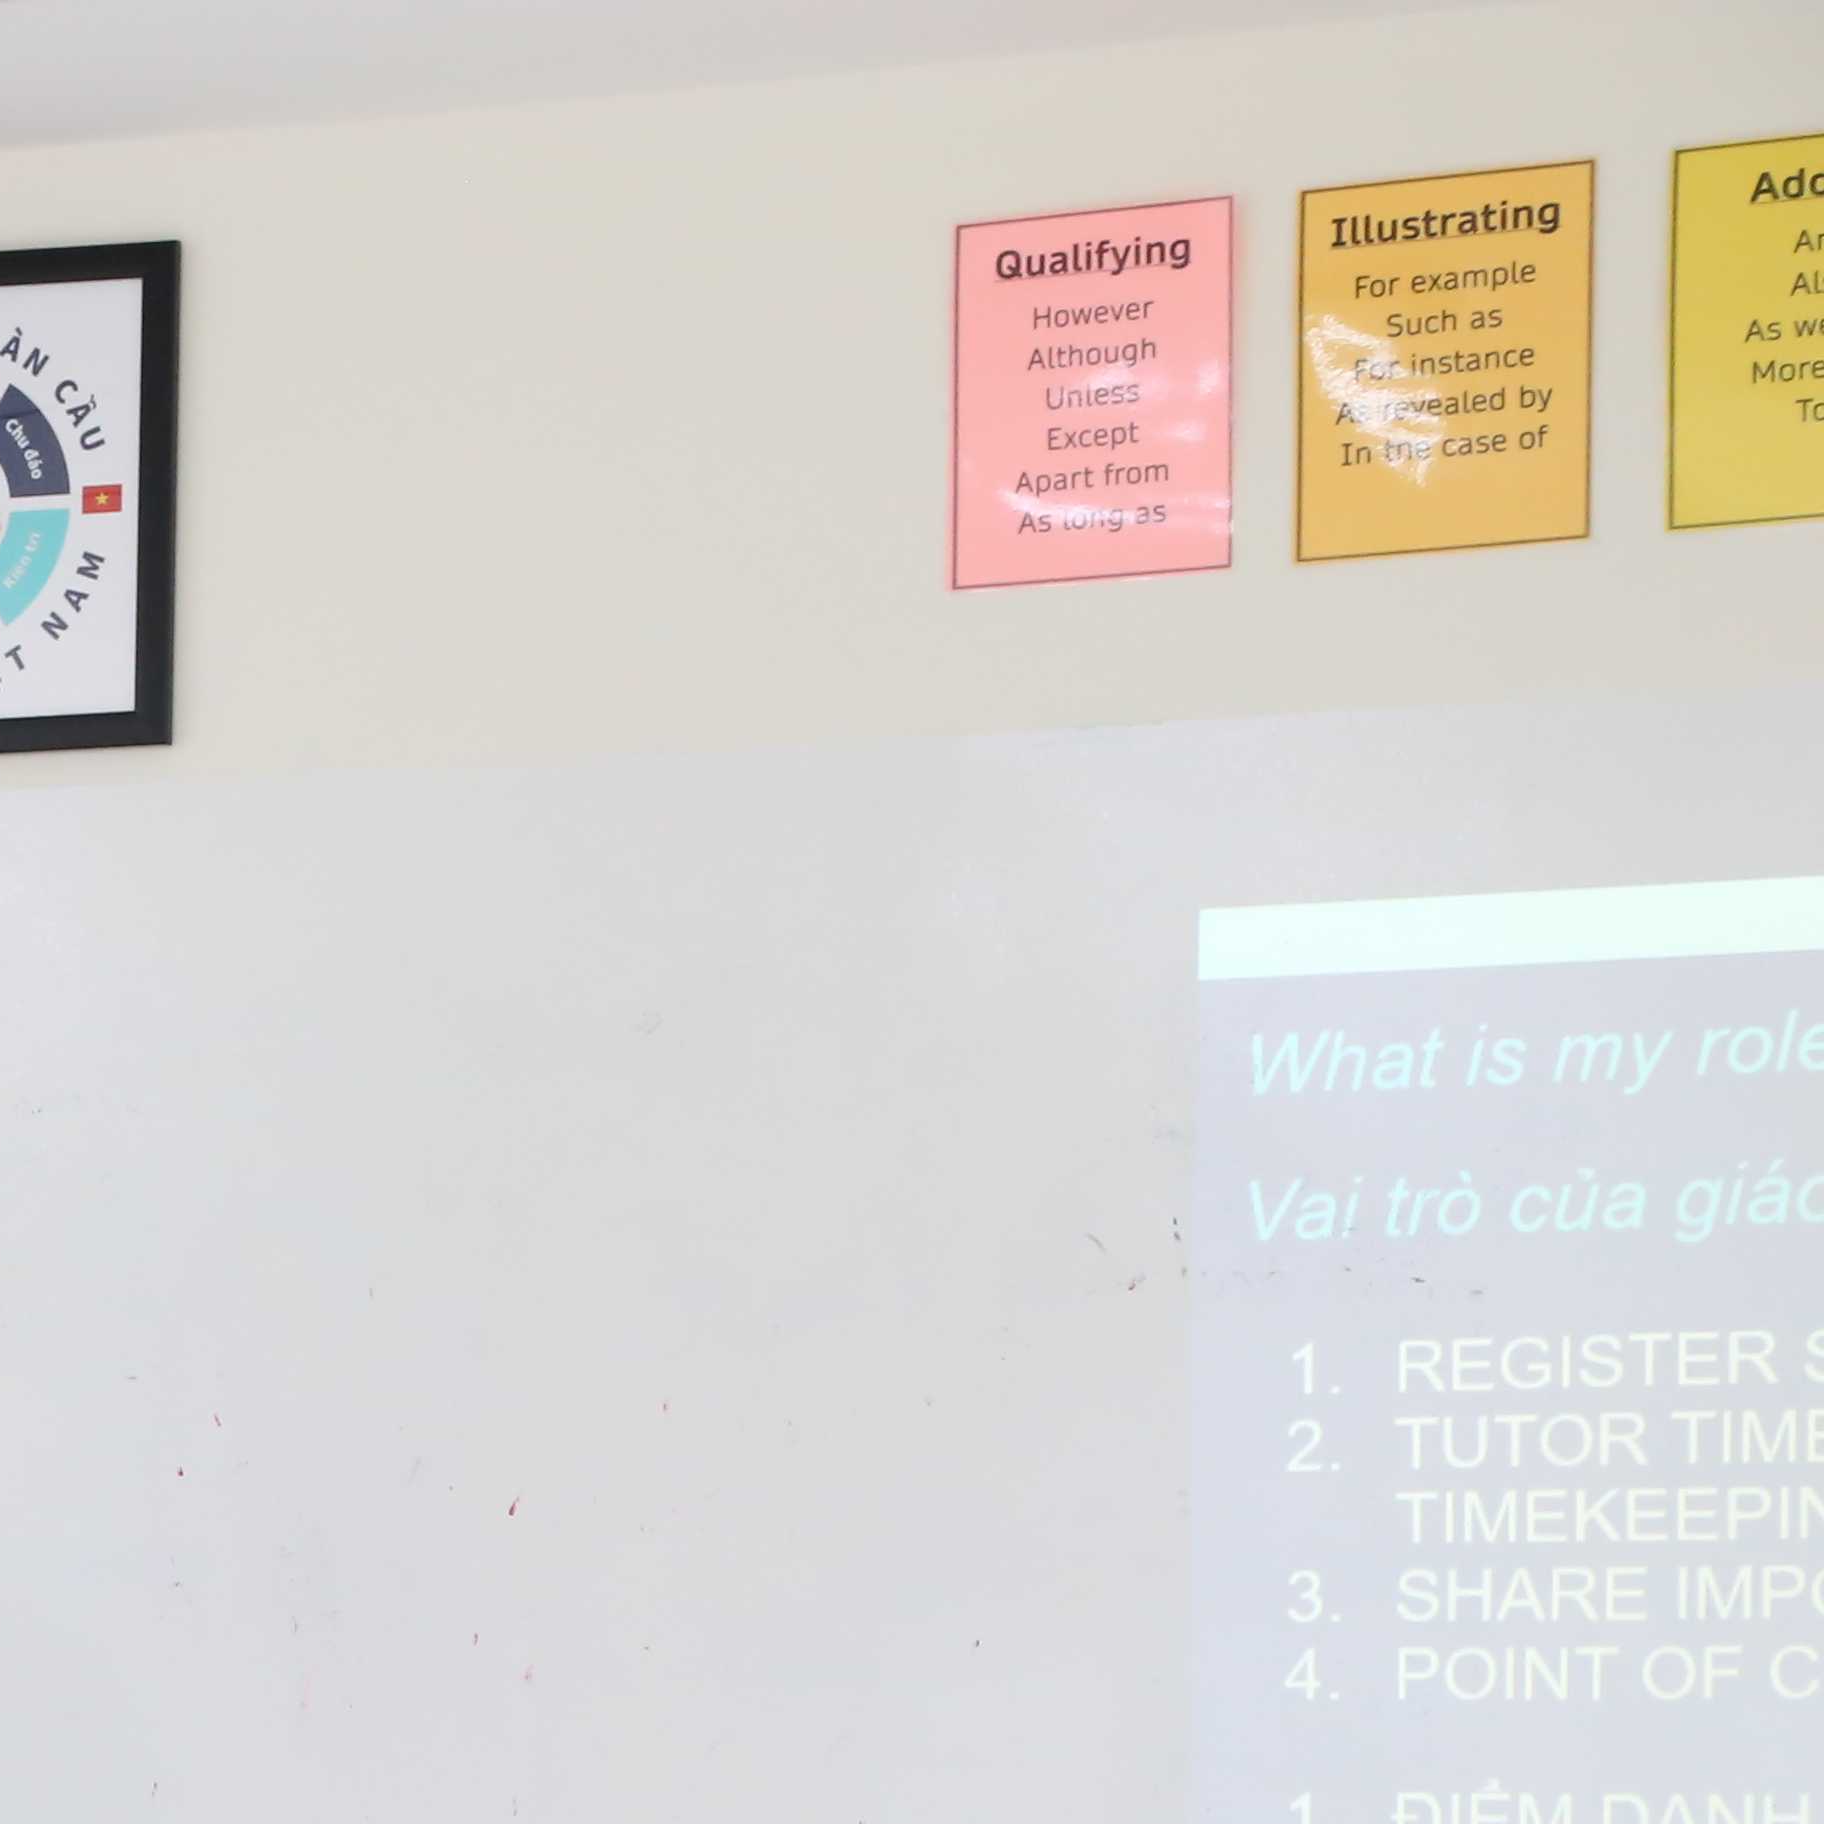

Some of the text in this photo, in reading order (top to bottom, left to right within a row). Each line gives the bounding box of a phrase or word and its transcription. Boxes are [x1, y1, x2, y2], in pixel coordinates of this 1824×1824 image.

[1331, 200, 1561, 248] Illustrating
[995, 237, 1191, 279] Qualifying
[1354, 260, 1537, 299] For example
[1790, 270, 1824, 297] Al
[1033, 300, 1154, 330] However
[1387, 307, 1503, 338] Such as
[1744, 319, 1781, 343] As
[1028, 338, 1157, 371] Although
[1411, 345, 1535, 377] instance
[54, 379, 105, 452] CẦU
[1046, 383, 1141, 410] Unless
[1383, 387, 1505, 422] revealed
[1520, 385, 1552, 413] by
[5, 419, 30, 449] Chu
[1047, 422, 1140, 451] Except
[1341, 441, 1372, 467] In
[1442, 432, 1506, 458] case
[1519, 424, 1549, 451] of
[1015, 462, 1169, 497] Apart from
[1017, 511, 1051, 535] As
[1137, 503, 1167, 525] as
[41, 551, 105, 640] NAM
[1251, 1025, 1444, 1096] What
[1466, 1023, 1528, 1088] is
[1552, 1027, 1676, 1095] my
[1249, 1176, 1364, 1241] Vai
[1384, 1170, 1483, 1239] trò
[1509, 1168, 1647, 1234] của
[1291, 1343, 1341, 1394] 1.
[1397, 1330, 1780, 1393] REGISTER
[1285, 1419, 1341, 1472] 2.
[1393, 1412, 1648, 1469] TUTOR
[1286, 1564, 1824, 1623] 3. SHARE IMP
[1283, 1647, 1341, 1700] 4.
[1396, 1644, 1620, 1700] POINT
[1641, 1644, 1743, 1700] OF
